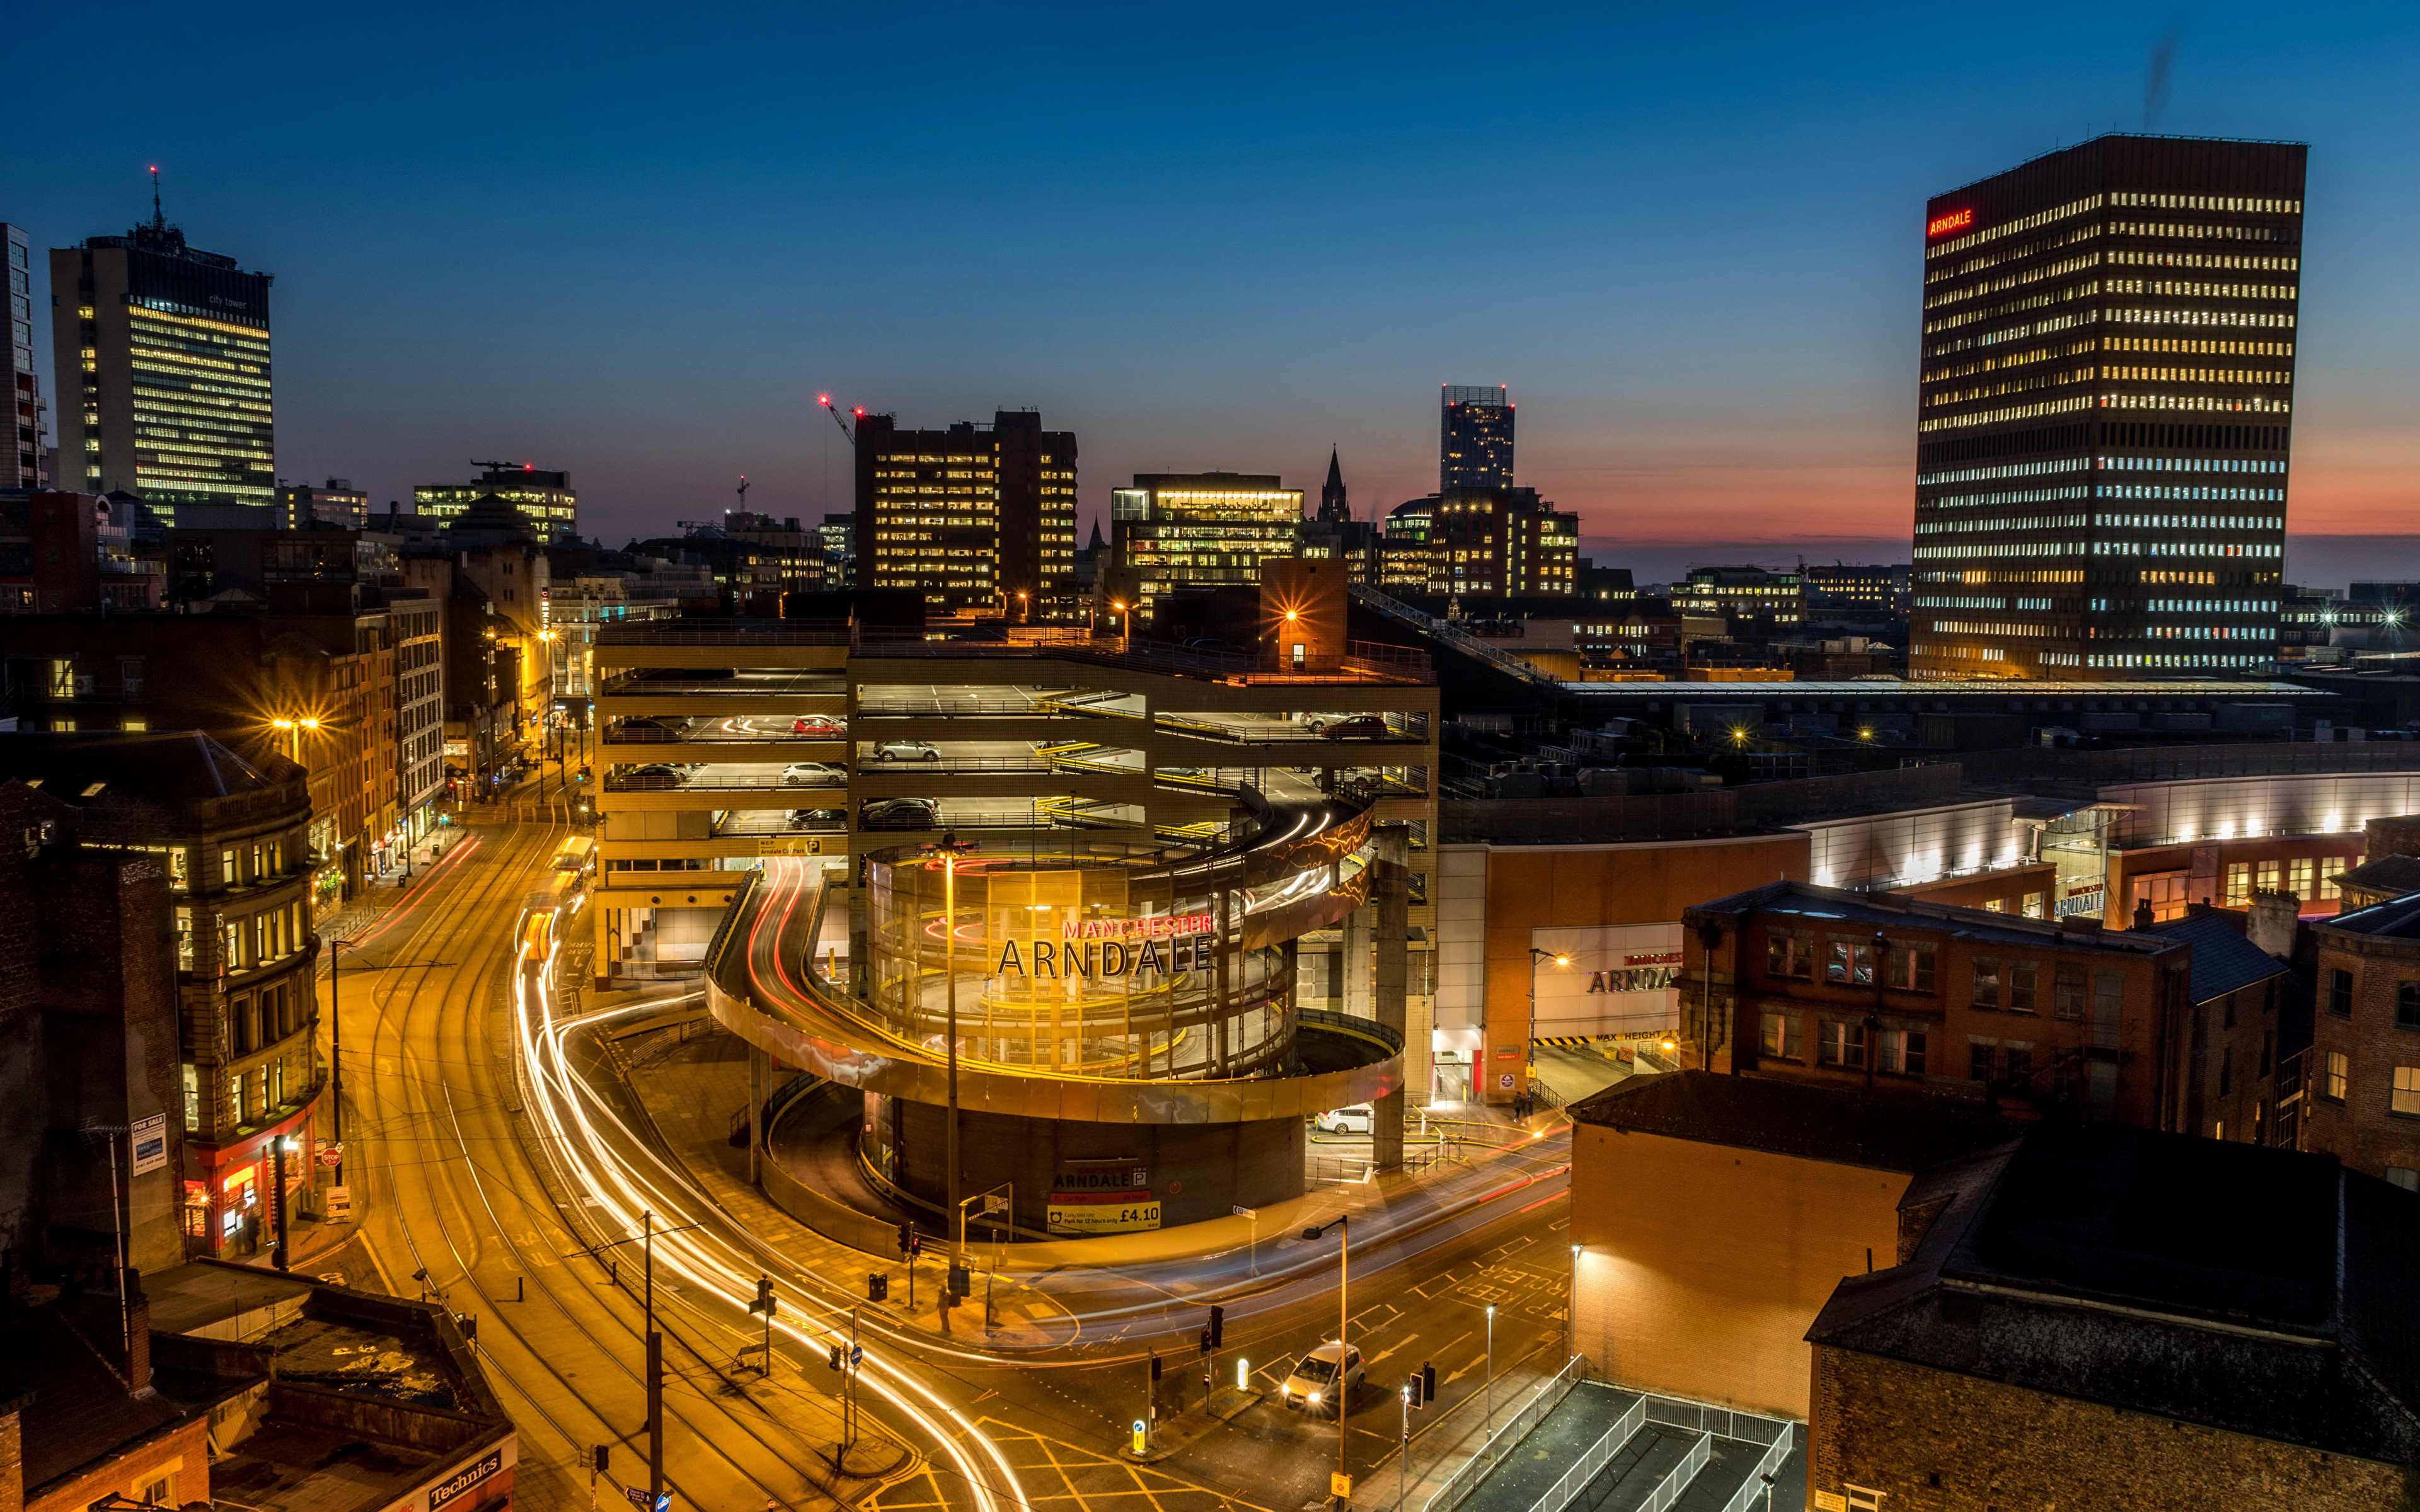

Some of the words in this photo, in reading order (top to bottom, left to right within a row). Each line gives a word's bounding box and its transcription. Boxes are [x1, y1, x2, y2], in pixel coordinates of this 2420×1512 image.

[1930, 209, 1971, 235] ARNDALE
[209, 294, 222, 307] city
[225, 297, 247, 309] tower
[1172, 624, 1187, 639] 13
[2054, 892, 2104, 917] ARNDALE
[1063, 915, 1212, 938] MANCHESTER
[215, 913, 227, 993] BASIL
[996, 935, 1212, 979] ARNDALE
[1625, 1031, 1661, 1040] HEIGHT
[134, 1123, 147, 1131] FOR
[148, 1117, 164, 1126] SALE
[1054, 1174, 1130, 1188] ARNDALE
[1120, 1207, 1159, 1223] £4.10
[1478, 1264, 1552, 1290] CLEAR
[1456, 1283, 1521, 1305] KEEP
[431, 1458, 498, 1505] Technics
